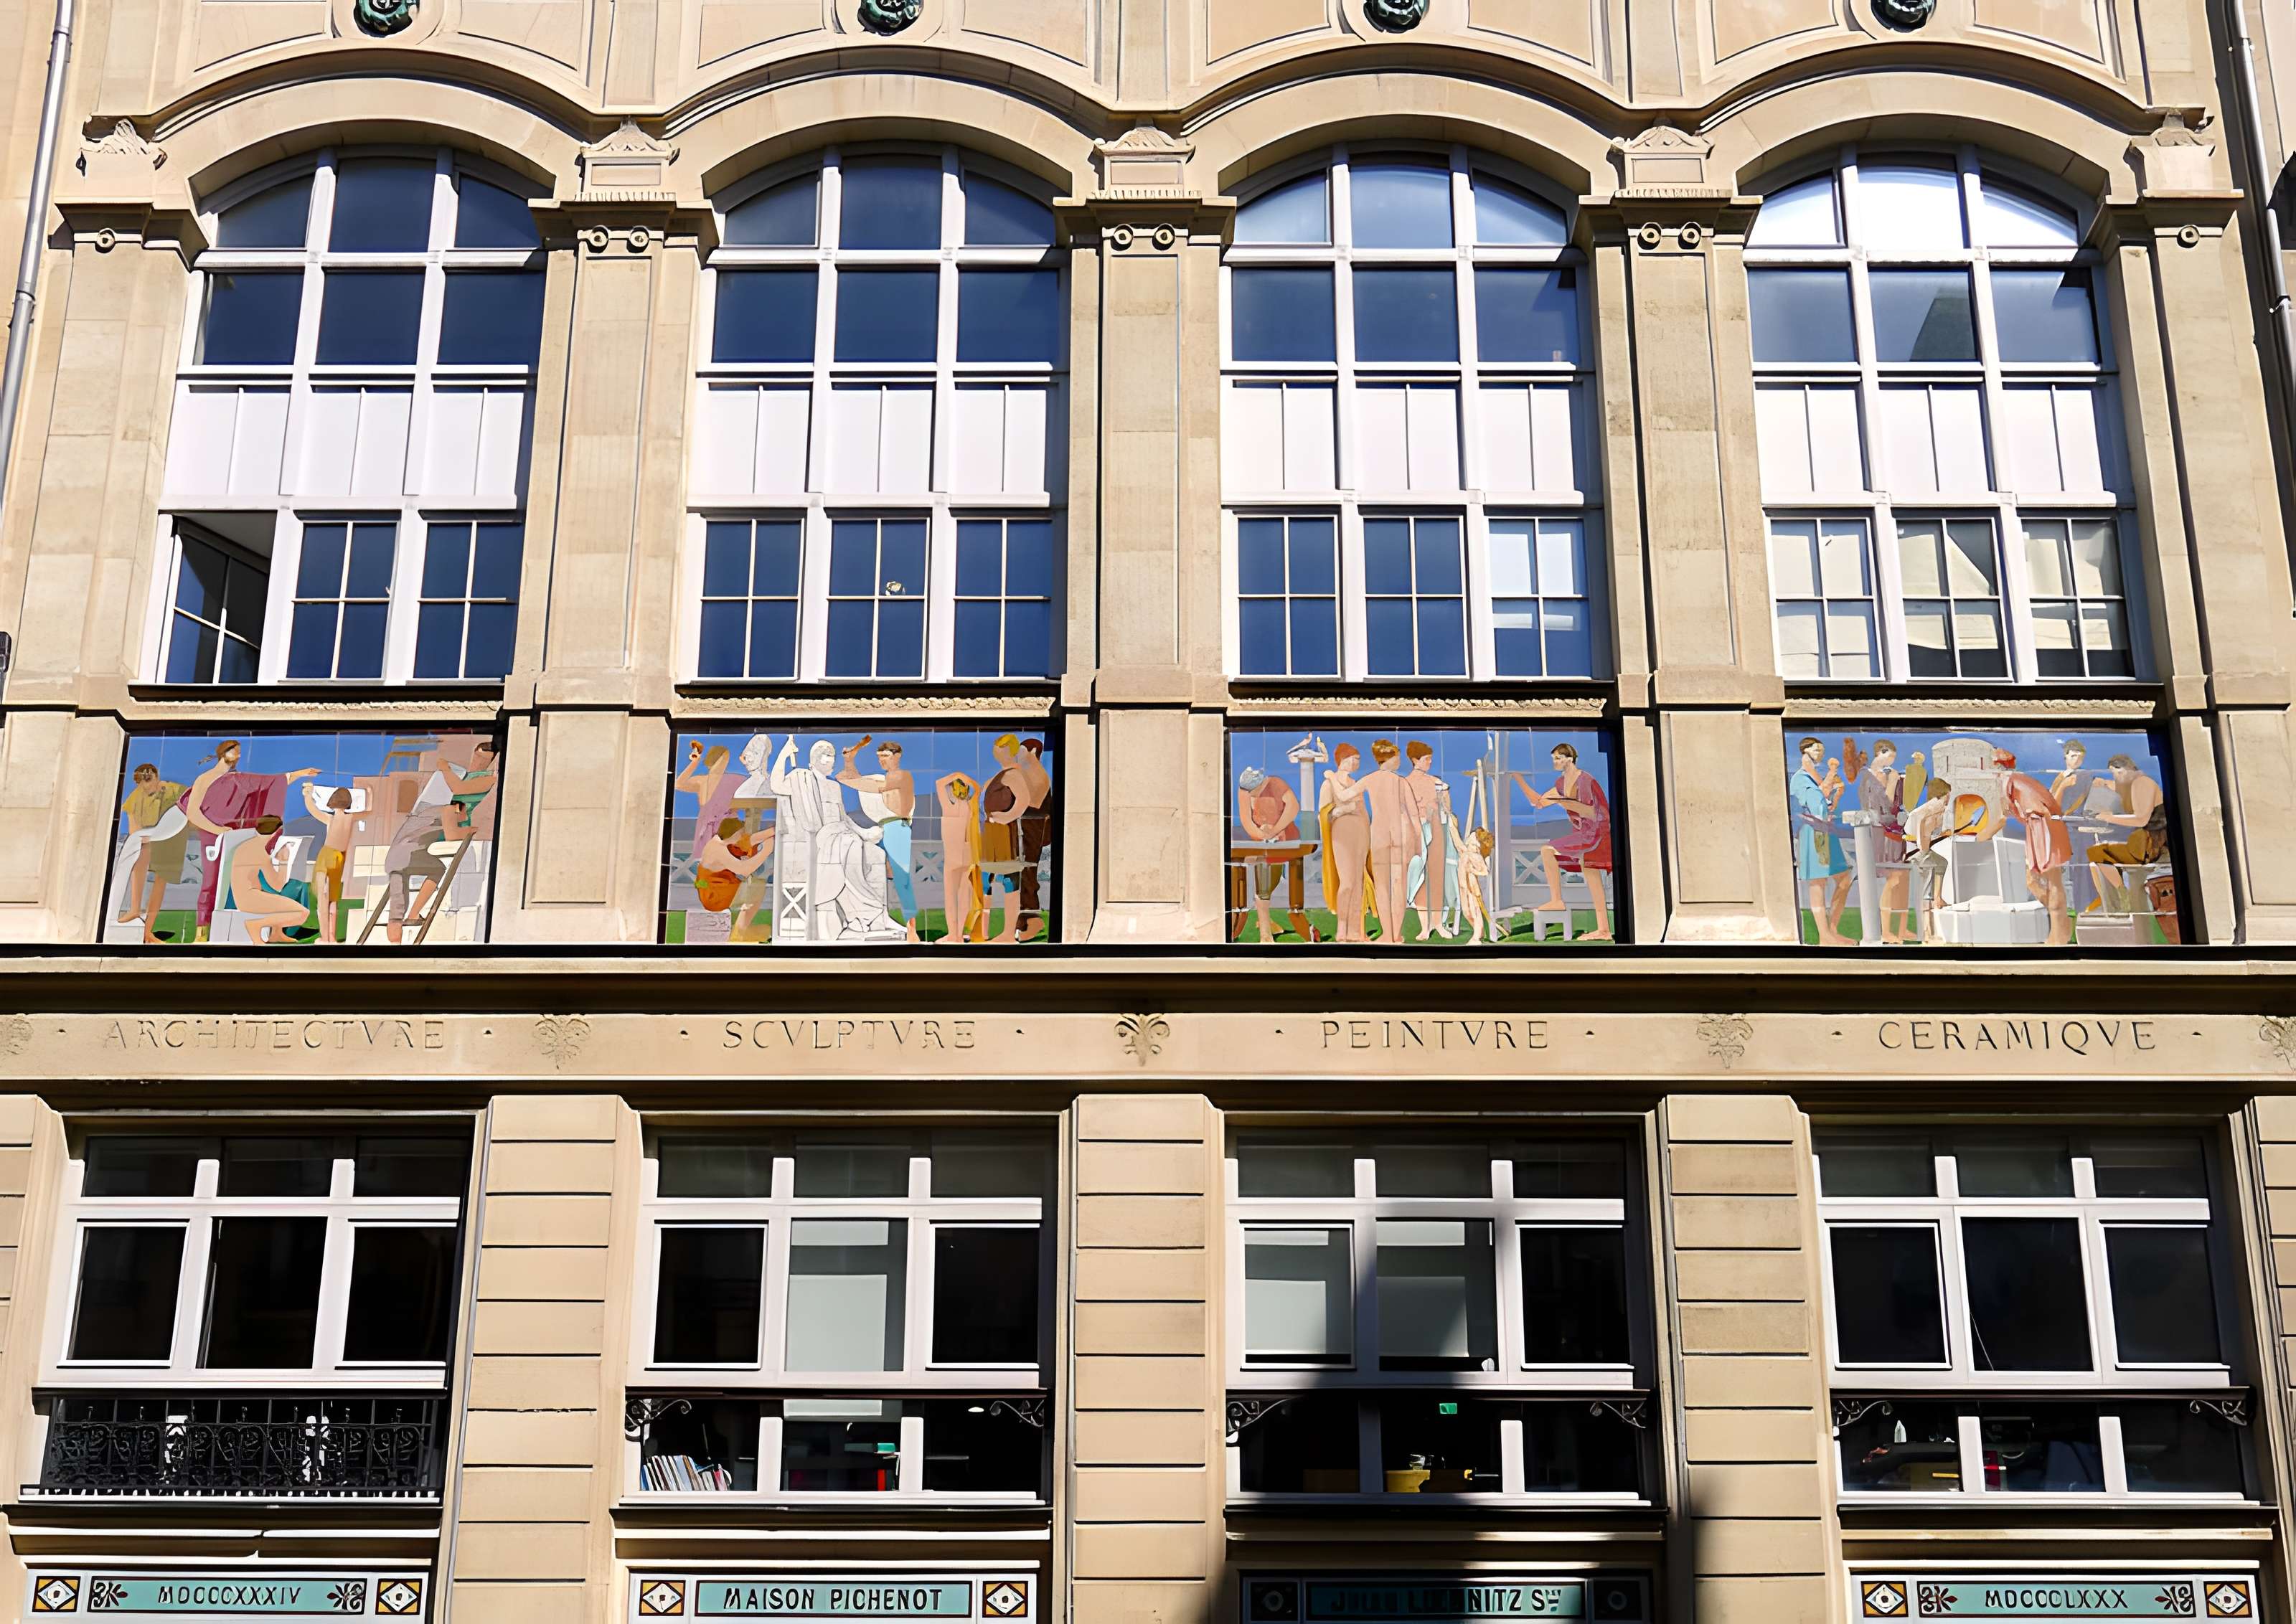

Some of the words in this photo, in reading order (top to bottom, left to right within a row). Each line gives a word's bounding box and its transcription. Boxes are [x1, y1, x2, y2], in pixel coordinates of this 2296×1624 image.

[723, 1021, 975, 1049] SCVLPTVRE
[1320, 1021, 1548, 1049] PEINTVRE
[1878, 1021, 2155, 1055] CERAMIQVE
[723, 1588, 814, 1610] MAISON
[831, 1588, 942, 1611] PICHENOT
